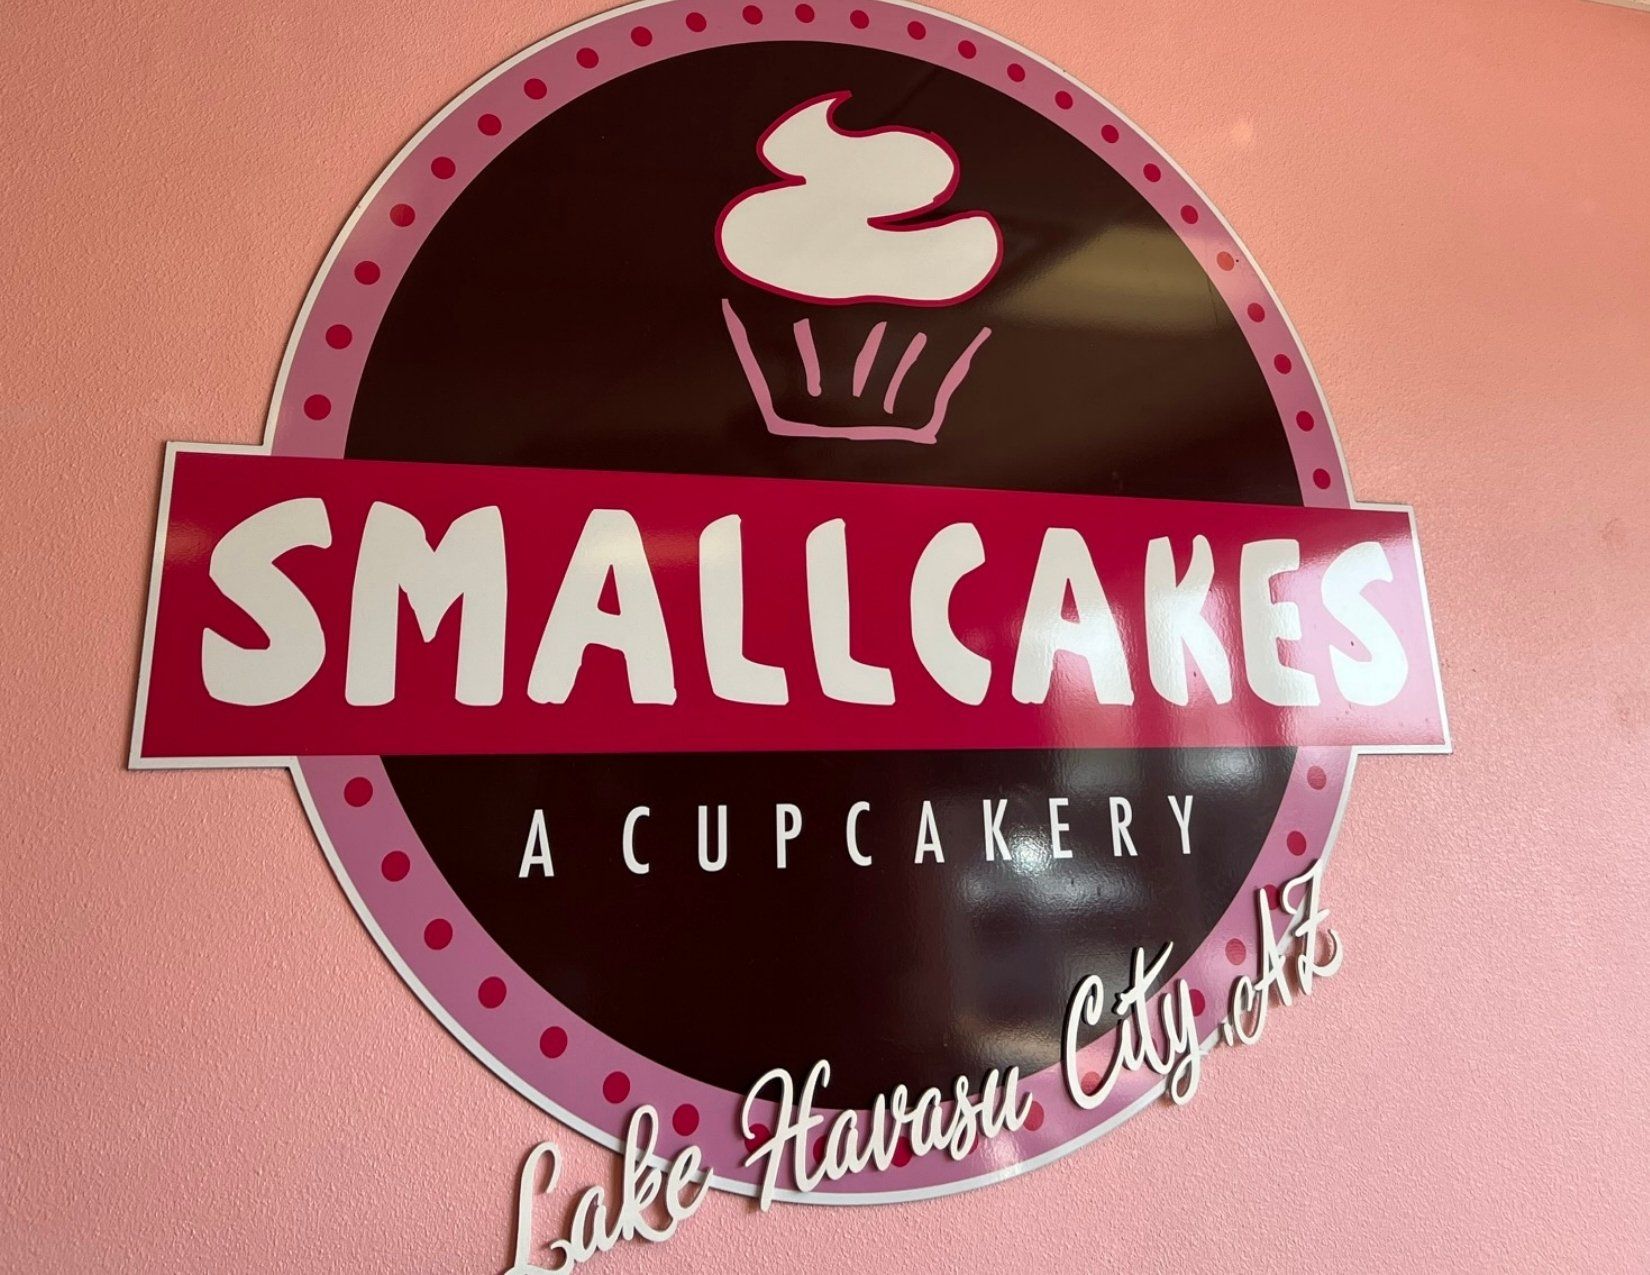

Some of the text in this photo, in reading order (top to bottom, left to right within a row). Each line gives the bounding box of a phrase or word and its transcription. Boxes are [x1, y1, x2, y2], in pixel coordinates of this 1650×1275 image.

[200, 496, 1409, 707] SMALLCAKES
[518, 795, 1197, 879] A CUPCAKERY
[503, 1105, 714, 1275] Lake
[742, 1059, 1034, 1213] Havasu
